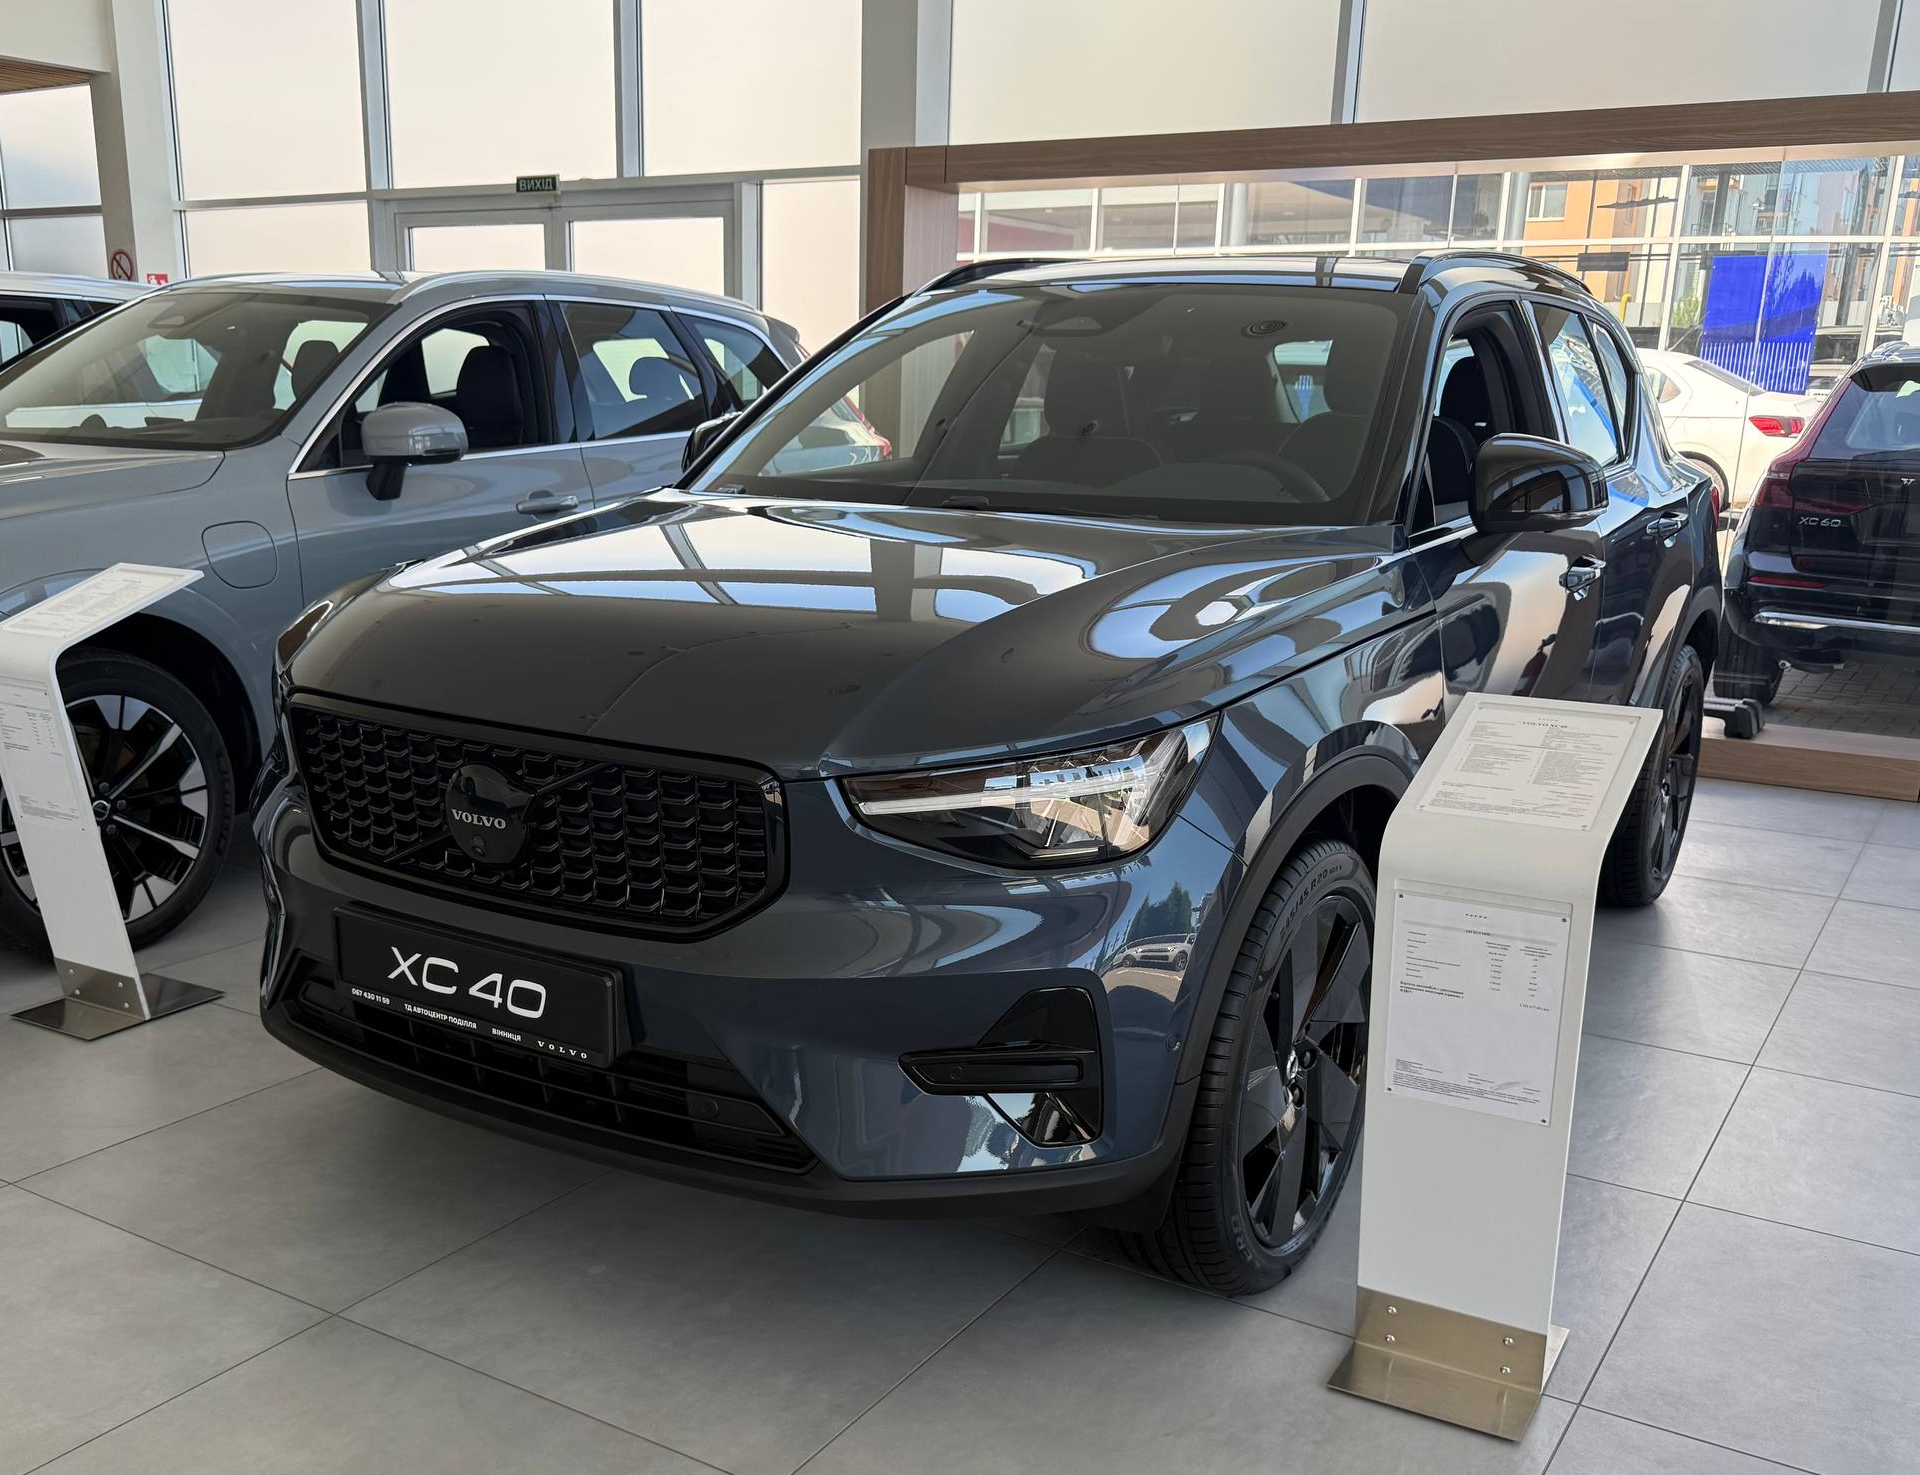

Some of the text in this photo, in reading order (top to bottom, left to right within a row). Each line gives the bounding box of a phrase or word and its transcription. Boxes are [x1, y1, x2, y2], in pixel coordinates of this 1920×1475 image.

[519, 178, 553, 191] ВИХІД
[451, 808, 507, 830] VOLVO
[404, 1003, 477, 1029] ТД АВТОЦЕНТР ПОДІЛЛЯ
[492, 1027, 522, 1042] ВІННИЦЯ
[537, 1040, 588, 1059] VOLVO
